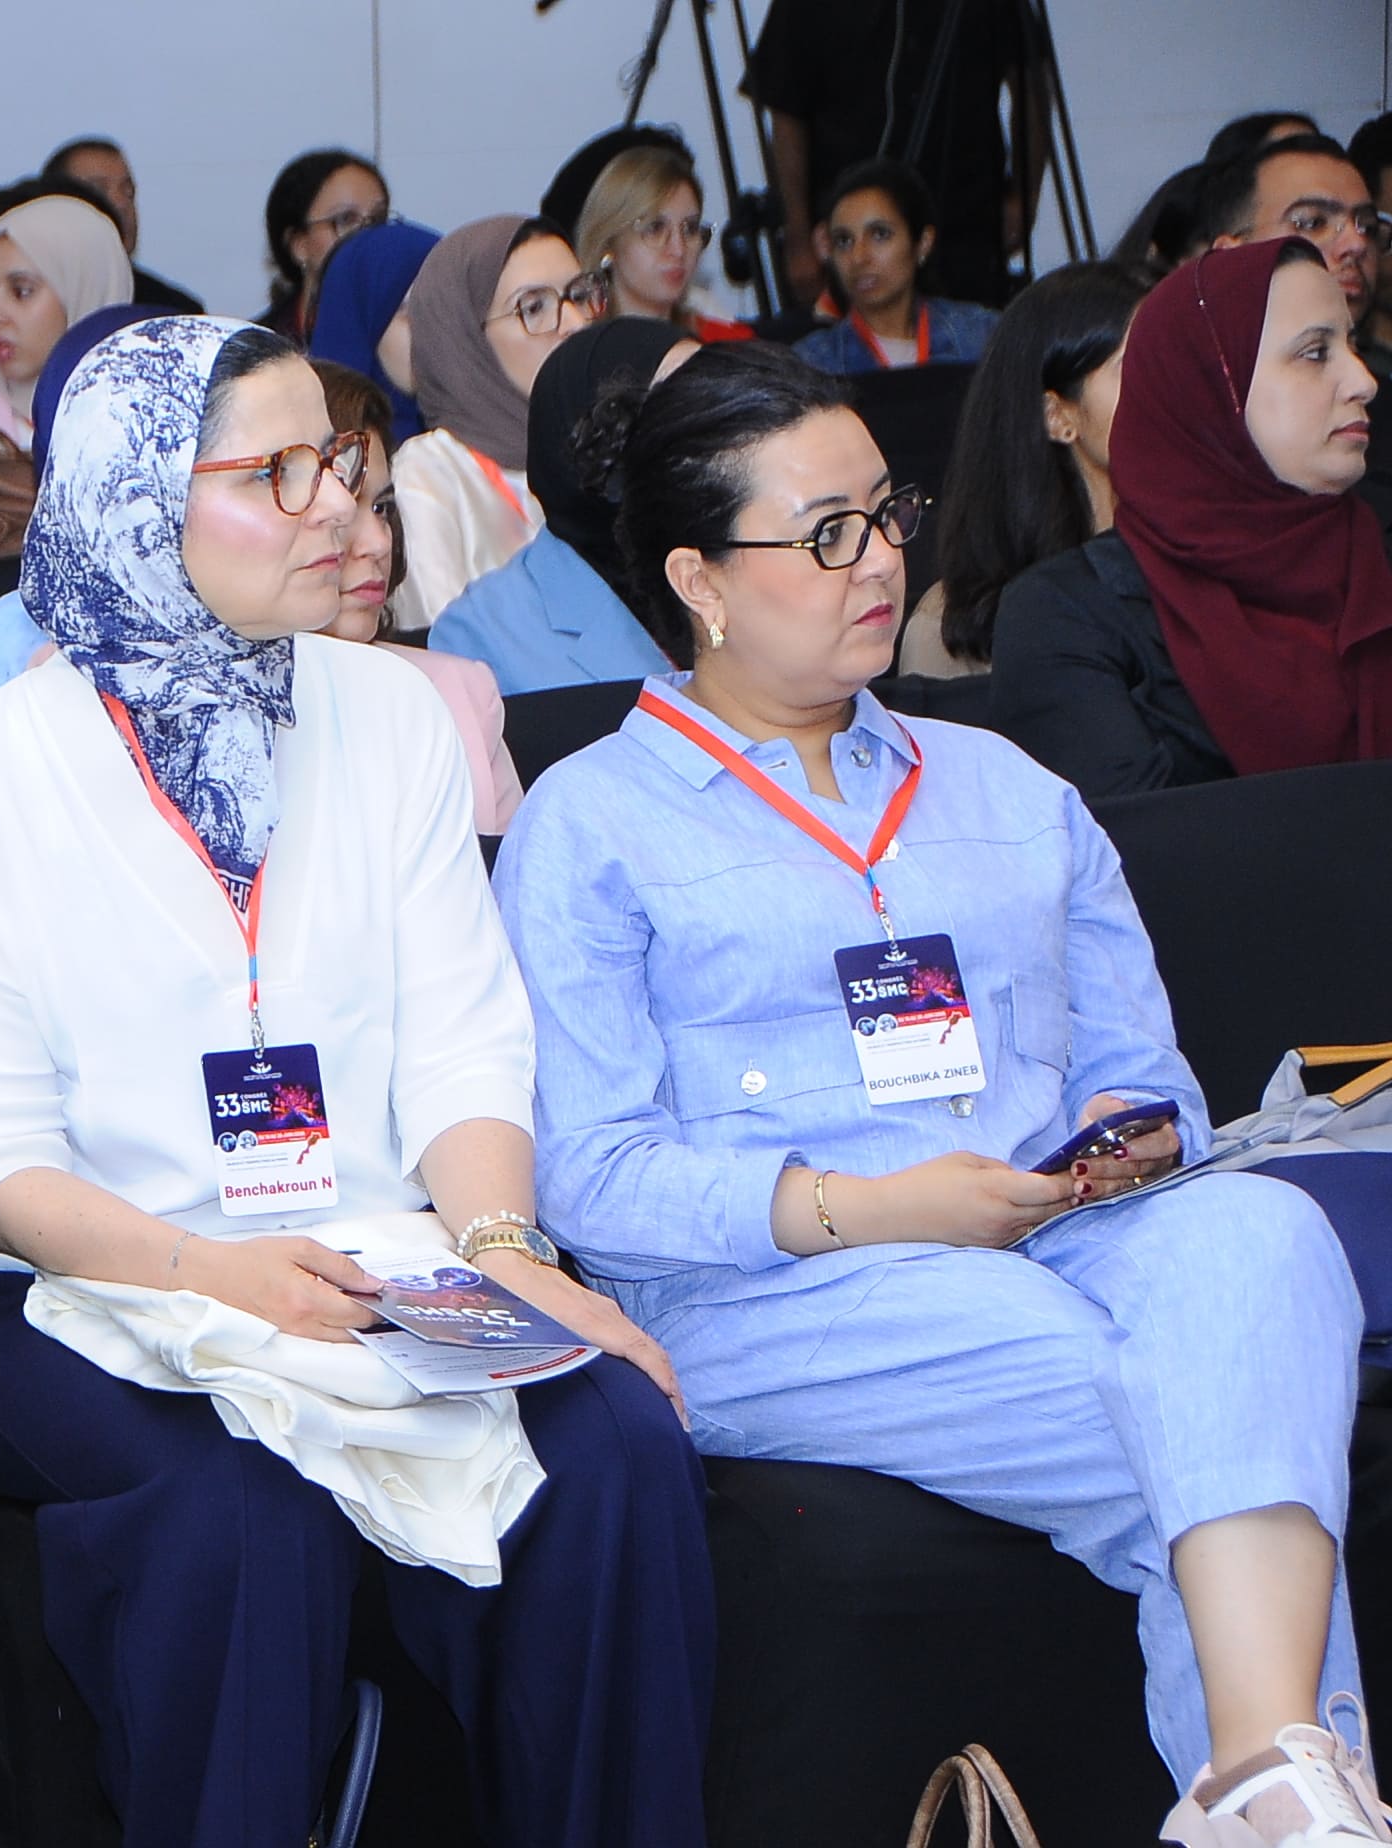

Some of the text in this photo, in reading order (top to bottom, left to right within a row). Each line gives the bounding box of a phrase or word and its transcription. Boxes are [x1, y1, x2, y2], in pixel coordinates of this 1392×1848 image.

[848, 978, 909, 1004] 33 SMC
[869, 1063, 980, 1091] BOUCHBIKA ZINEB
[214, 1092, 272, 1118] 33 SMC
[224, 1175, 333, 1199] Benchakroun N
